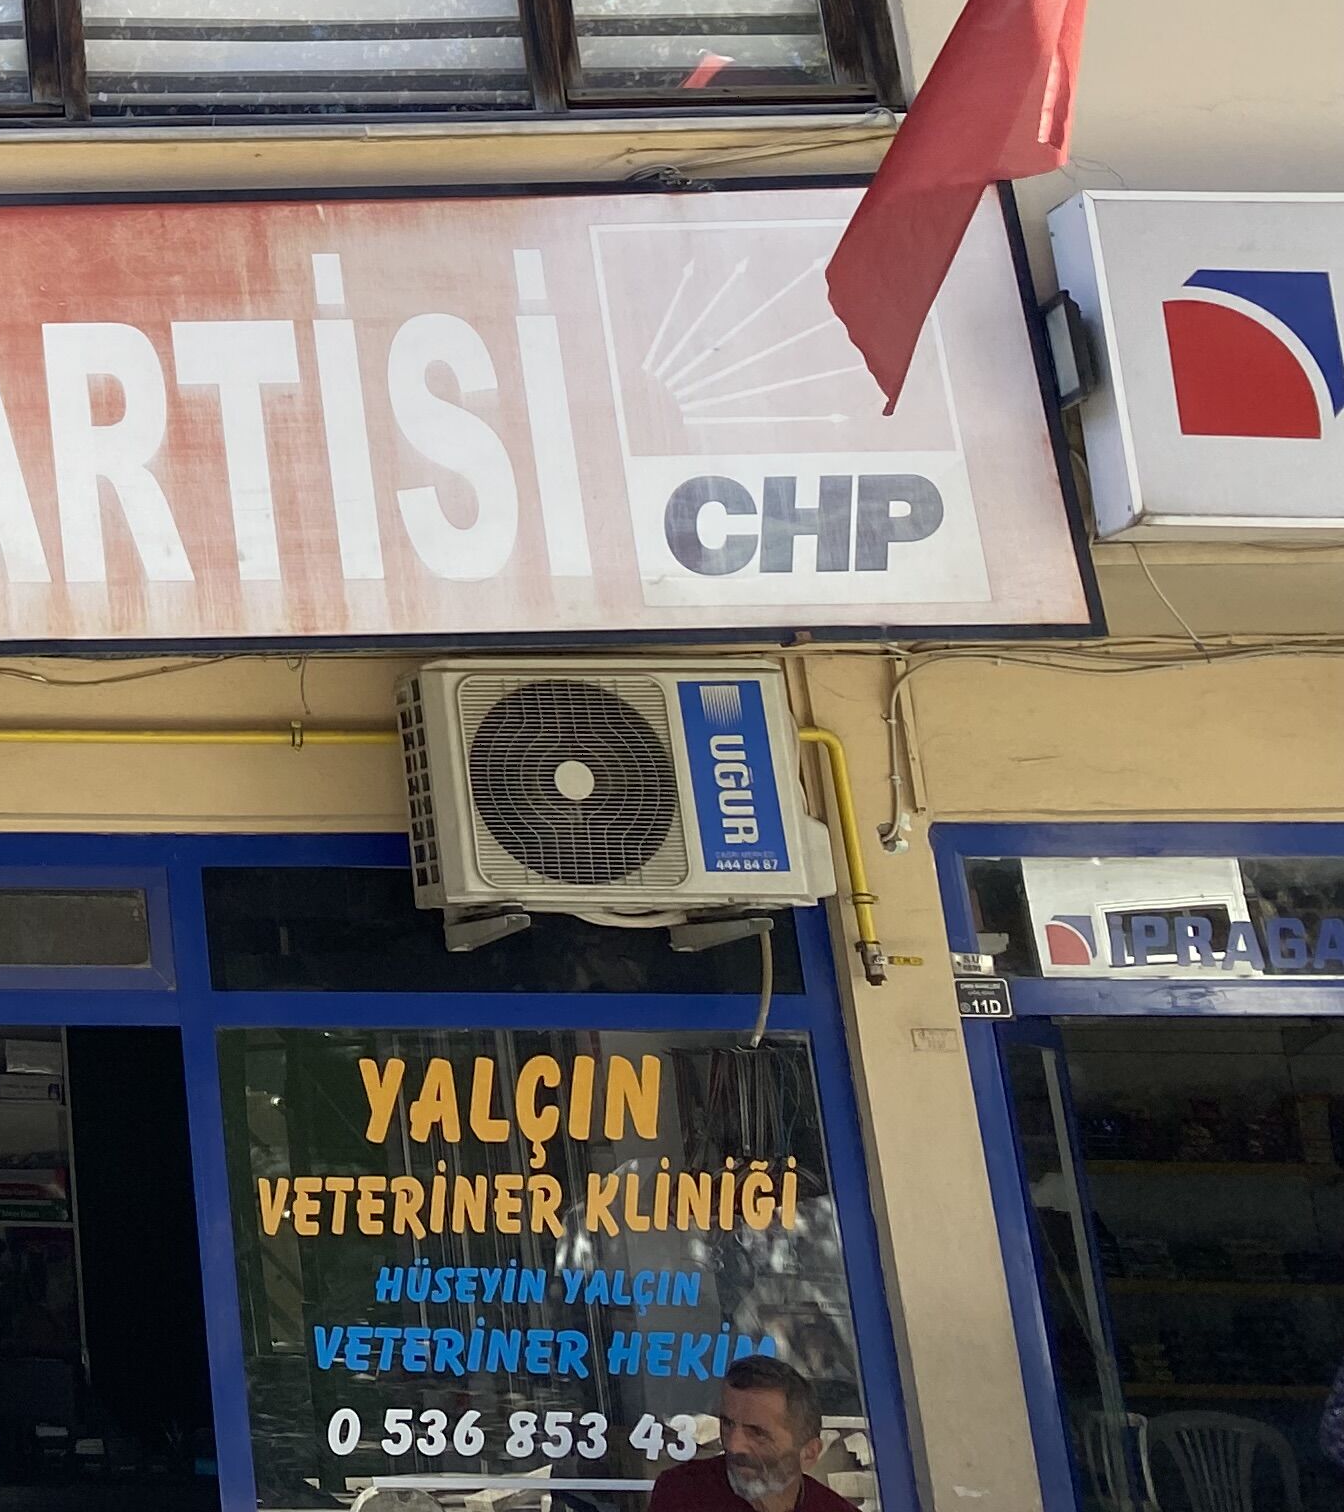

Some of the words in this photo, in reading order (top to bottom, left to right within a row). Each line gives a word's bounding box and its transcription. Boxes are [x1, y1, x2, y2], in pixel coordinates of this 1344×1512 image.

[663, 473, 943, 577] CHP
[709, 734, 760, 844] UĞUR
[716, 859, 741, 870] 444
[743, 859, 760, 870] 84
[762, 858, 779, 870] 87
[972, 999, 1001, 1014] 11D
[358, 1054, 661, 1168] YALÇIN
[257, 1159, 564, 1240] VETERİNER
[585, 1156, 798, 1237] KLİNİĞİ
[375, 1257, 545, 1306] HÜSEYİN
[562, 1266, 701, 1316] YALÇIN
[312, 1317, 589, 1380] VETERİNER
[327, 1407, 361, 1456] 0
[380, 1407, 485, 1457] 536
[505, 1410, 609, 1461] 853
[629, 1412, 698, 1462] 43
